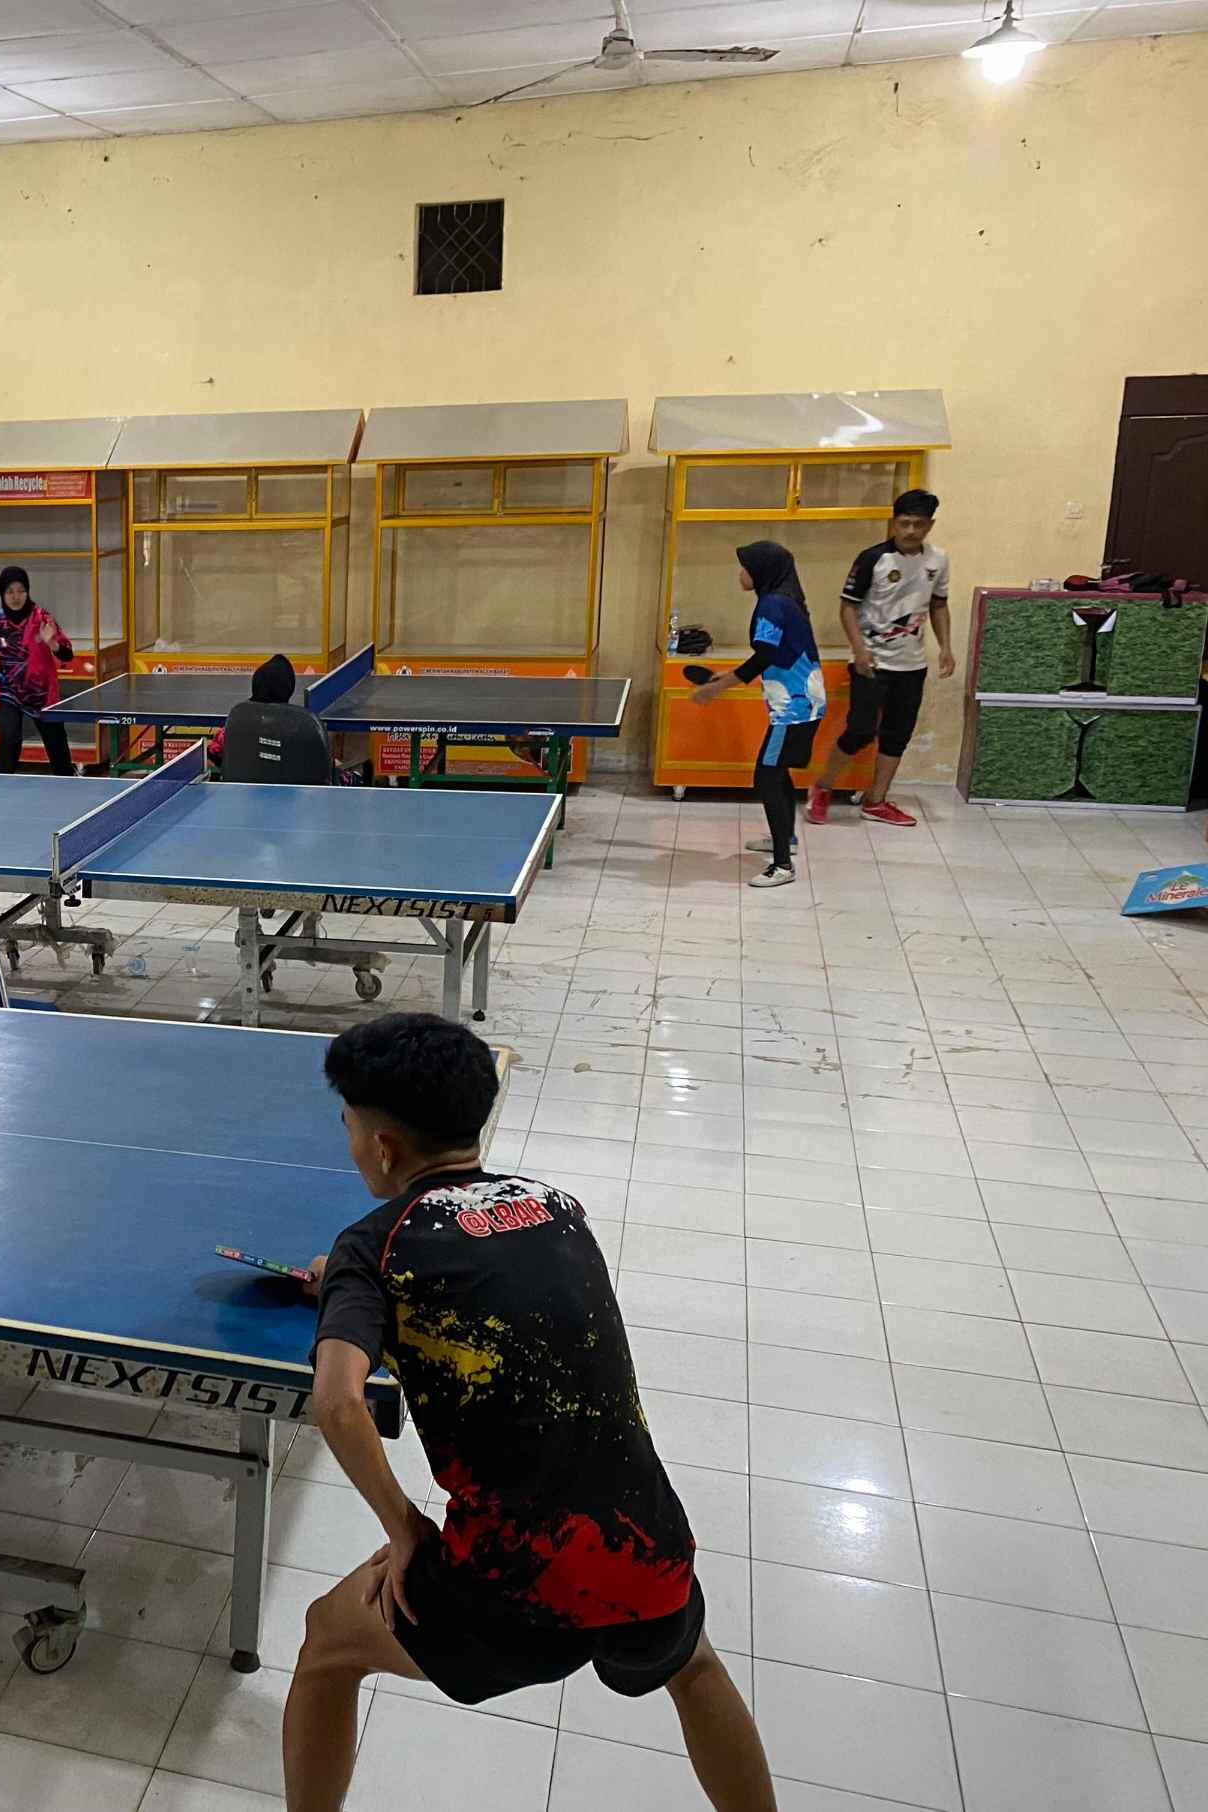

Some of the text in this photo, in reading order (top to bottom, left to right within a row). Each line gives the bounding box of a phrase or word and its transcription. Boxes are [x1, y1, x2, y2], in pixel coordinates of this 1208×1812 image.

[122, 717, 136, 725] 201
[369, 725, 457, 733] www.powerspin.co.id
[321, 894, 485, 920] NEXTSIST
[27, 1348, 316, 1421] NEXTSIST
